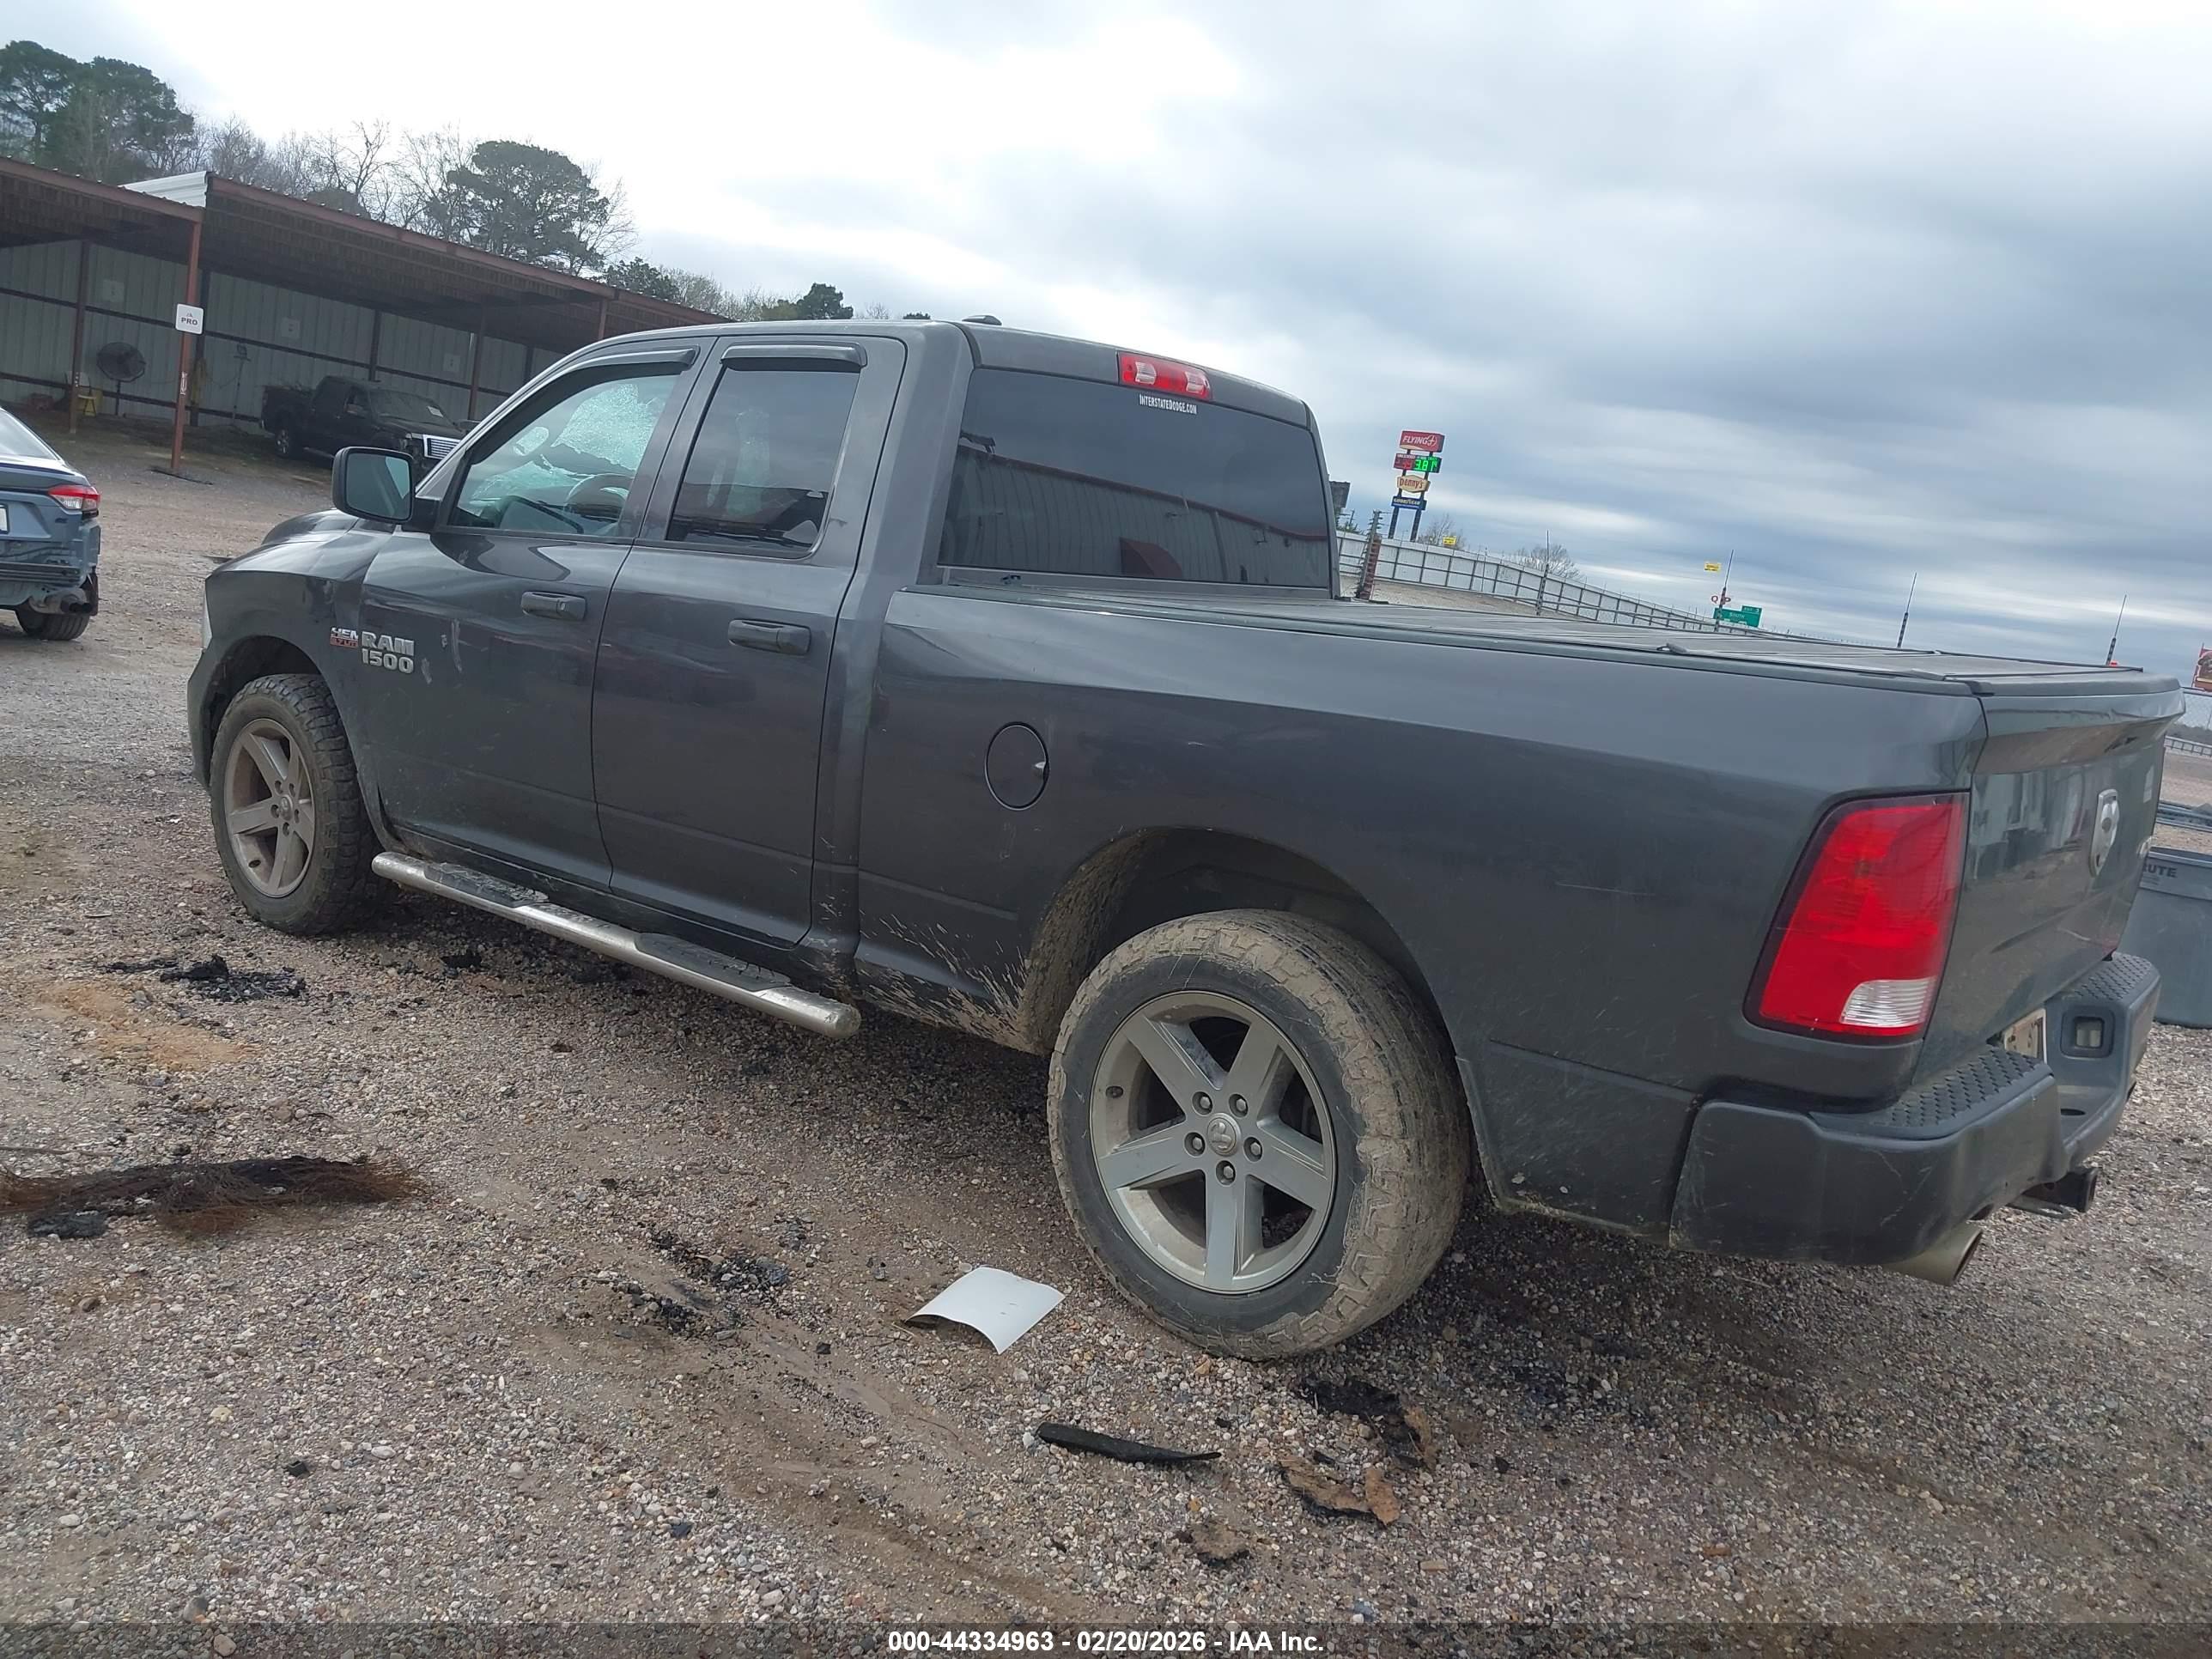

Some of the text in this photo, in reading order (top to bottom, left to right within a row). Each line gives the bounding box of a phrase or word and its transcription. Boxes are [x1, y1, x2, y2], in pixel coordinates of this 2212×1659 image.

[180, 317, 198, 325] PRO
[1402, 435, 1428, 445] FLYING
[1400, 477, 1423, 489] Denny's
[362, 631, 414, 656] RAM
[362, 648, 414, 674] 1500
